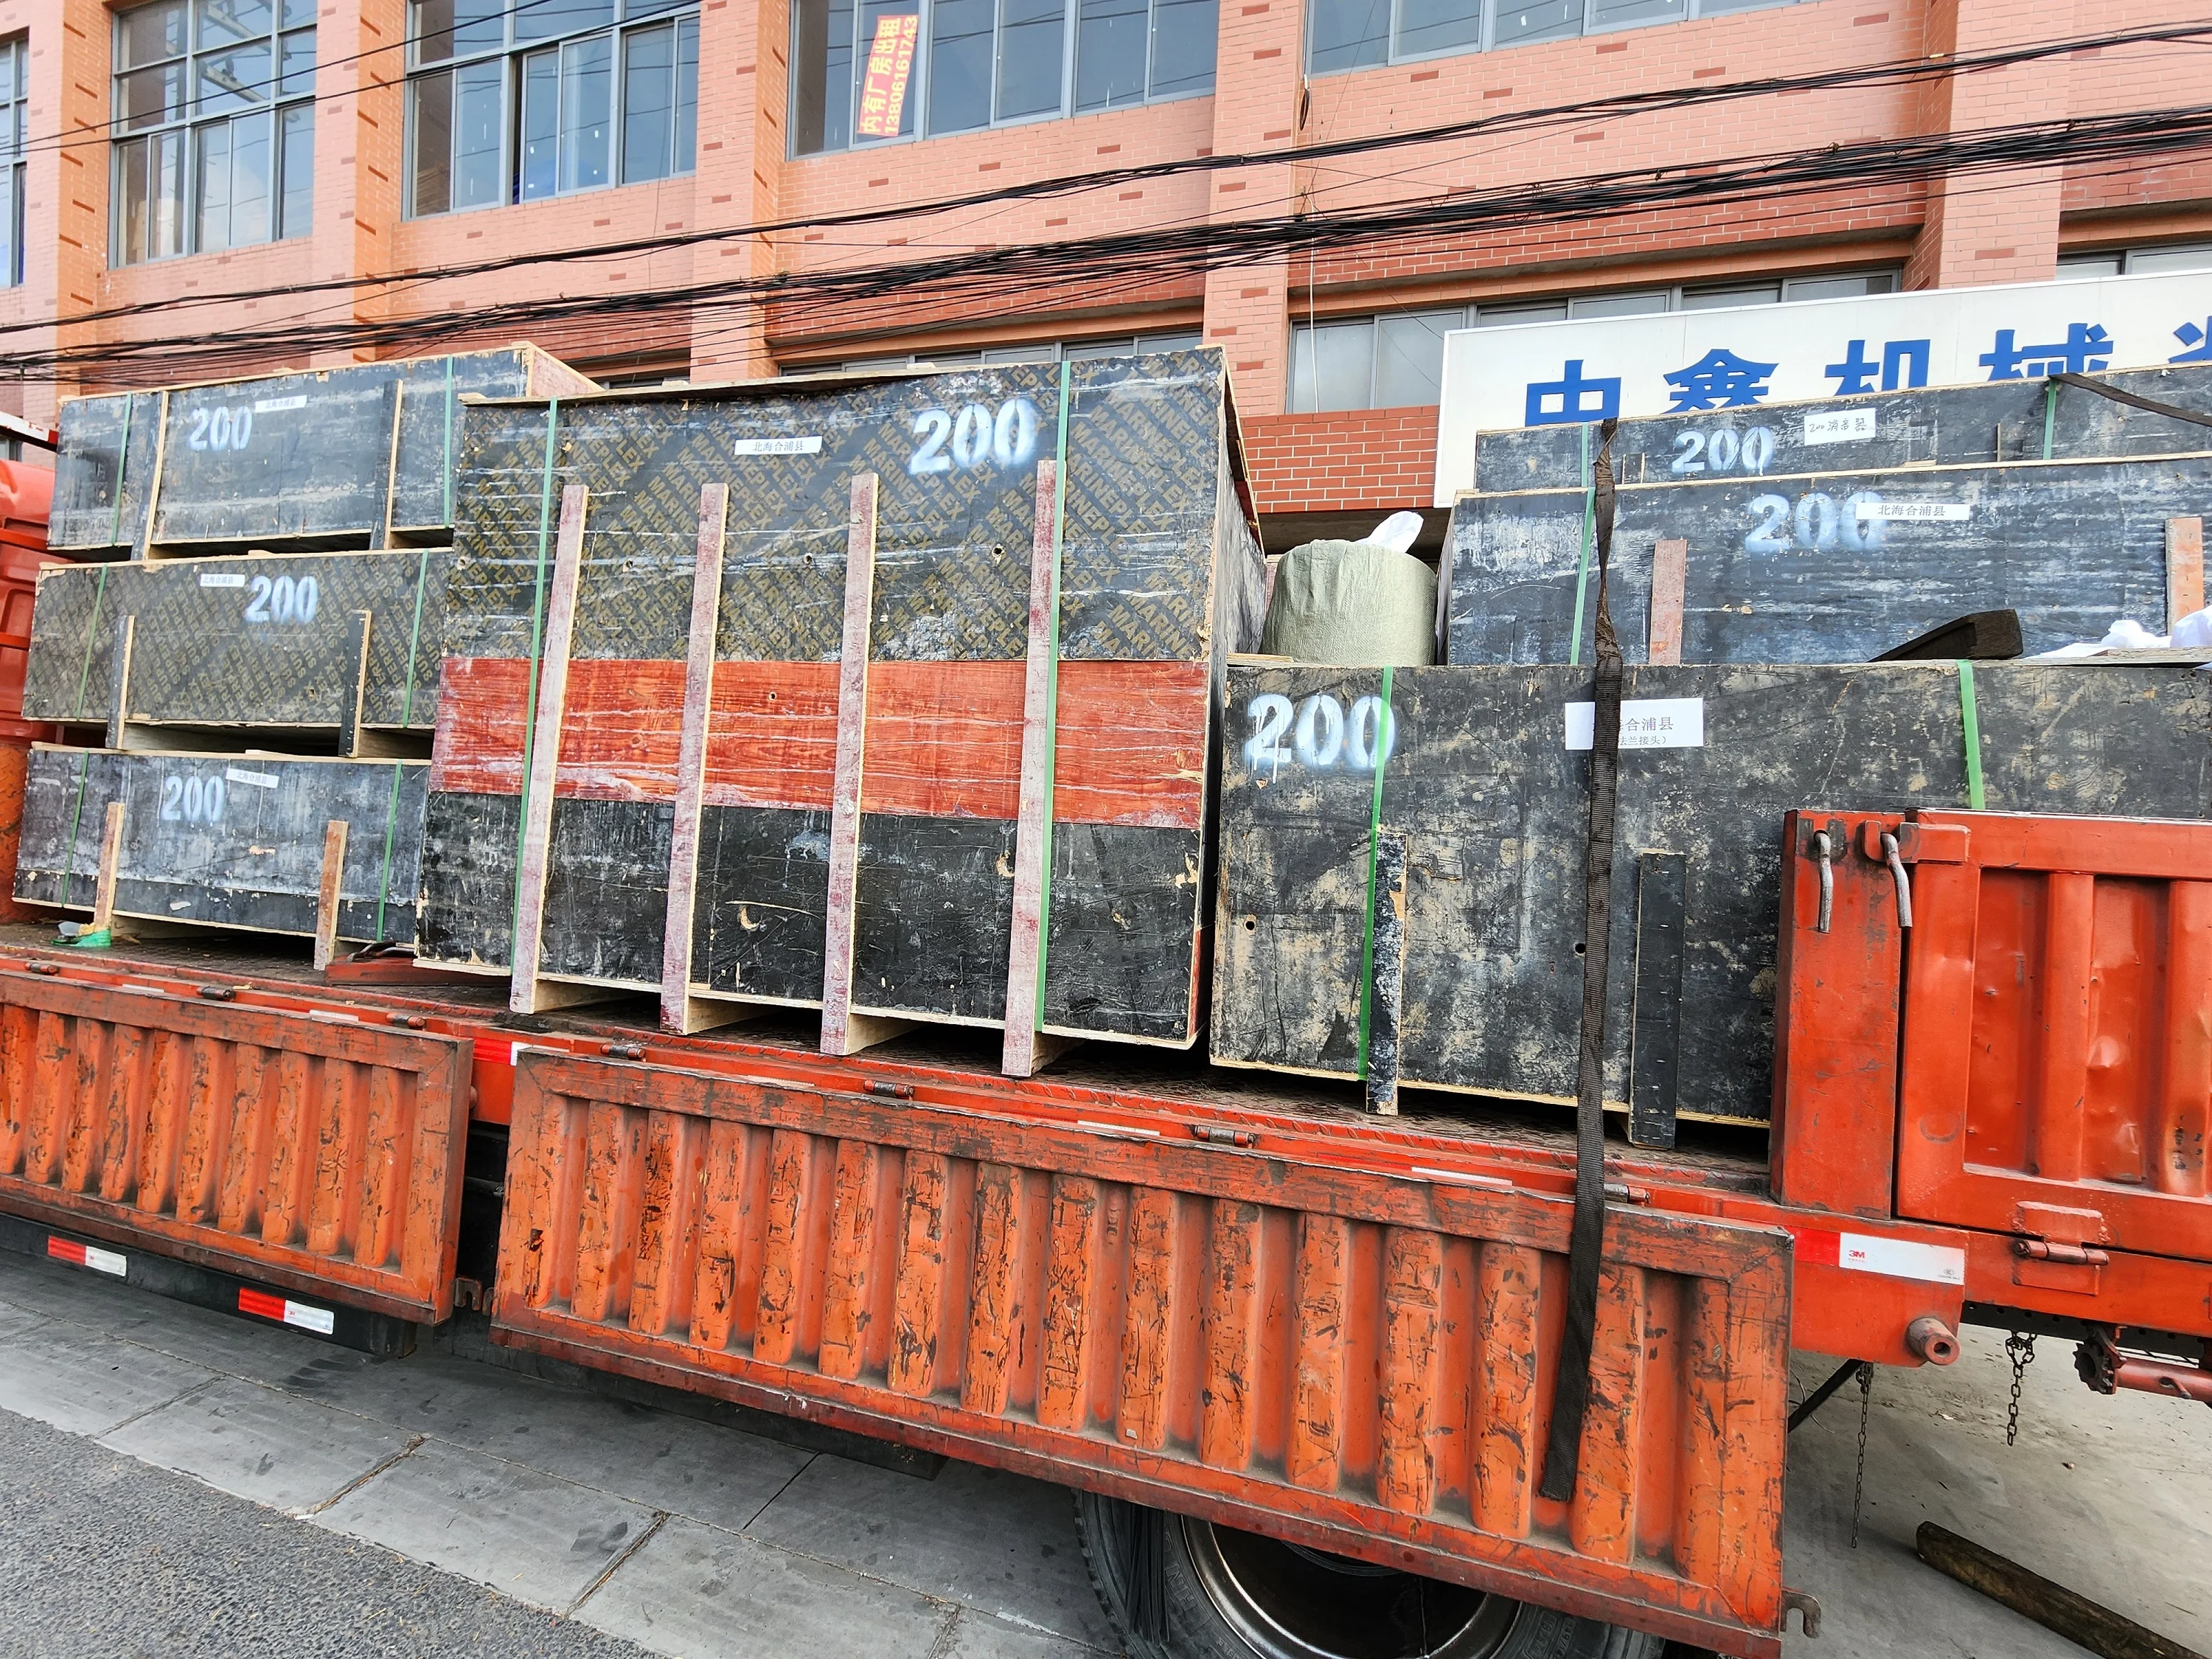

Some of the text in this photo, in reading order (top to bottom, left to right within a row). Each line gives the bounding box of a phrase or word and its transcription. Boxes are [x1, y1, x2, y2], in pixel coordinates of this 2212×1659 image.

[860, 18, 902, 133] 内有厂房出租
[885, 15, 919, 135] 13806161743
[189, 406, 253, 451] 200
[753, 440, 804, 452] 北海合浦县
[909, 398, 1037, 474] 200
[1672, 426, 1774, 473] 200
[1068, 421, 1178, 535] MARINEPLEX
[1745, 492, 1886, 551] 200
[1878, 504, 1946, 516] 北海合浦县
[245, 575, 319, 624] 200
[1245, 694, 1396, 769] 200
[1619, 717, 1674, 731] 合浦县
[1619, 735, 1667, 746] 法兰接头）
[161, 776, 225, 821] 200
[1848, 1250, 1865, 1259] 3M
